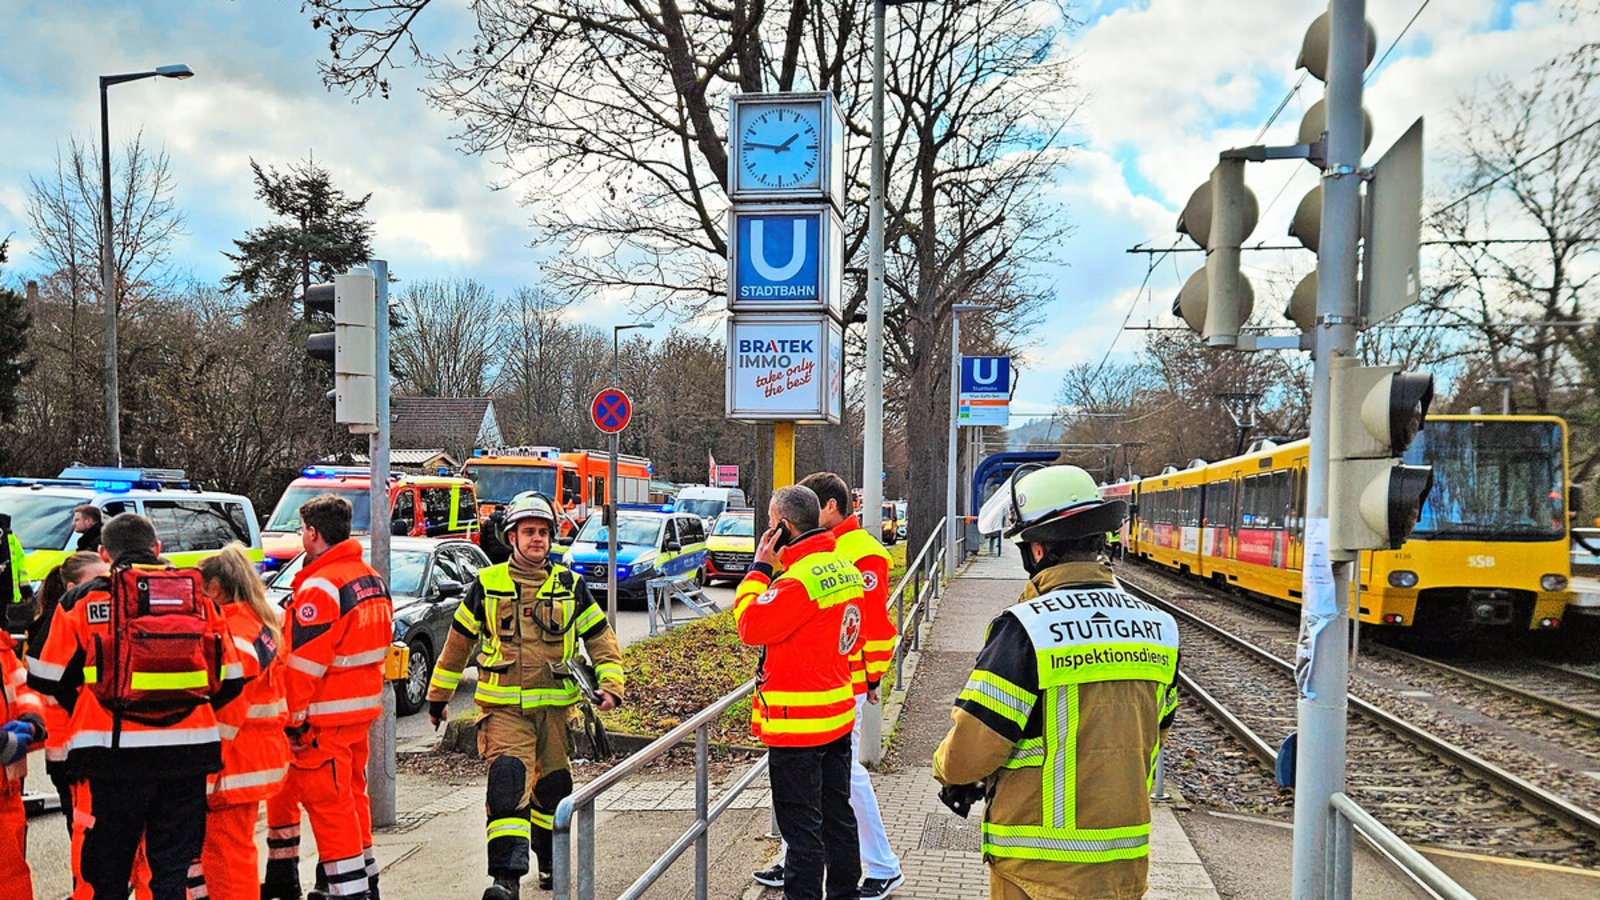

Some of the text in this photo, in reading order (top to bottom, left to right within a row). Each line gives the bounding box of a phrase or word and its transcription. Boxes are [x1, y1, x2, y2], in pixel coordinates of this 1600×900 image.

[751, 219, 807, 281] U
[740, 285, 815, 297] STADTBAHN
[739, 339, 814, 353] BRATEK
[739, 354, 792, 369] IMMO
[756, 357, 815, 388] take only
[973, 358, 999, 385] U
[764, 371, 812, 398] the best
[490, 449, 539, 458] FEUERWEHR
[1468, 555, 1496, 568] SSB
[820, 576, 837, 591] RD
[1049, 618, 1162, 643] STUTTGART
[1050, 648, 1169, 670] Inspektionsdienst
